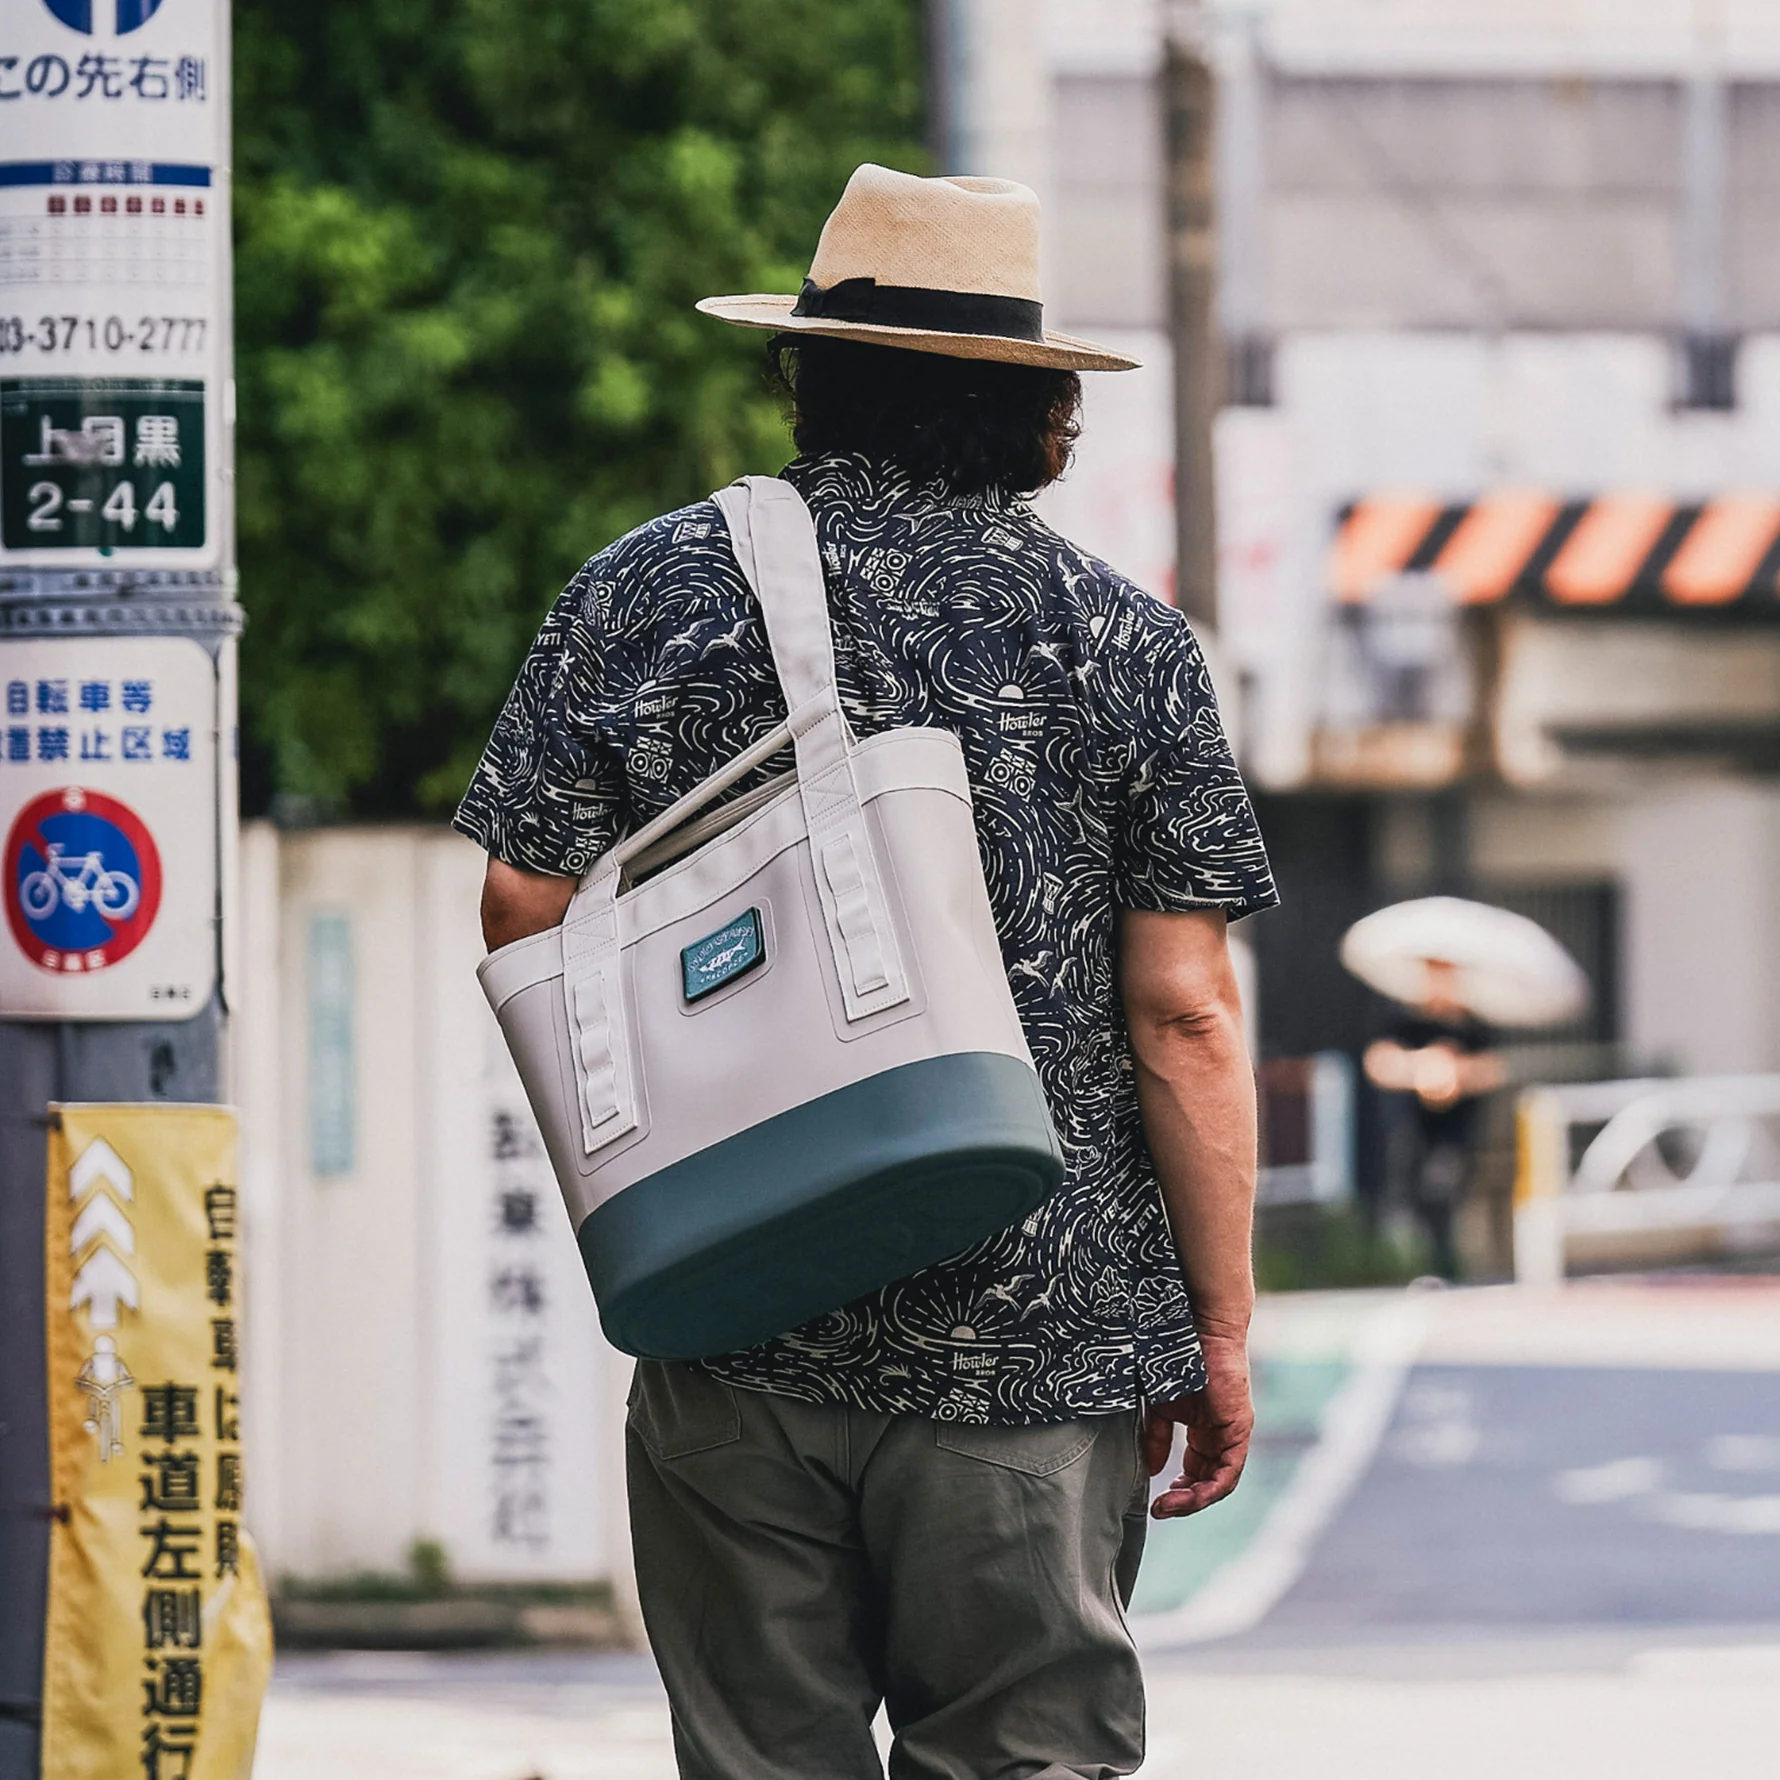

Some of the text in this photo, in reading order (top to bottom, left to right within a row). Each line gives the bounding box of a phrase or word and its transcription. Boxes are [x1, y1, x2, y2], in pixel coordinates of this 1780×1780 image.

[22, 414, 182, 467] 上目黒
[27, 481, 180, 532] 2-44
[537, 633, 560, 645] YETI
[7, 679, 152, 714] 自転車等
[631, 695, 679, 718] Howler
[996, 711, 1047, 731] Howler
[0, 725, 190, 761] 置禁止区域
[1128, 1203, 1158, 1237] YETI
[949, 1352, 1000, 1371] Howler
[139, 1381, 204, 1780] 車道左側通行
